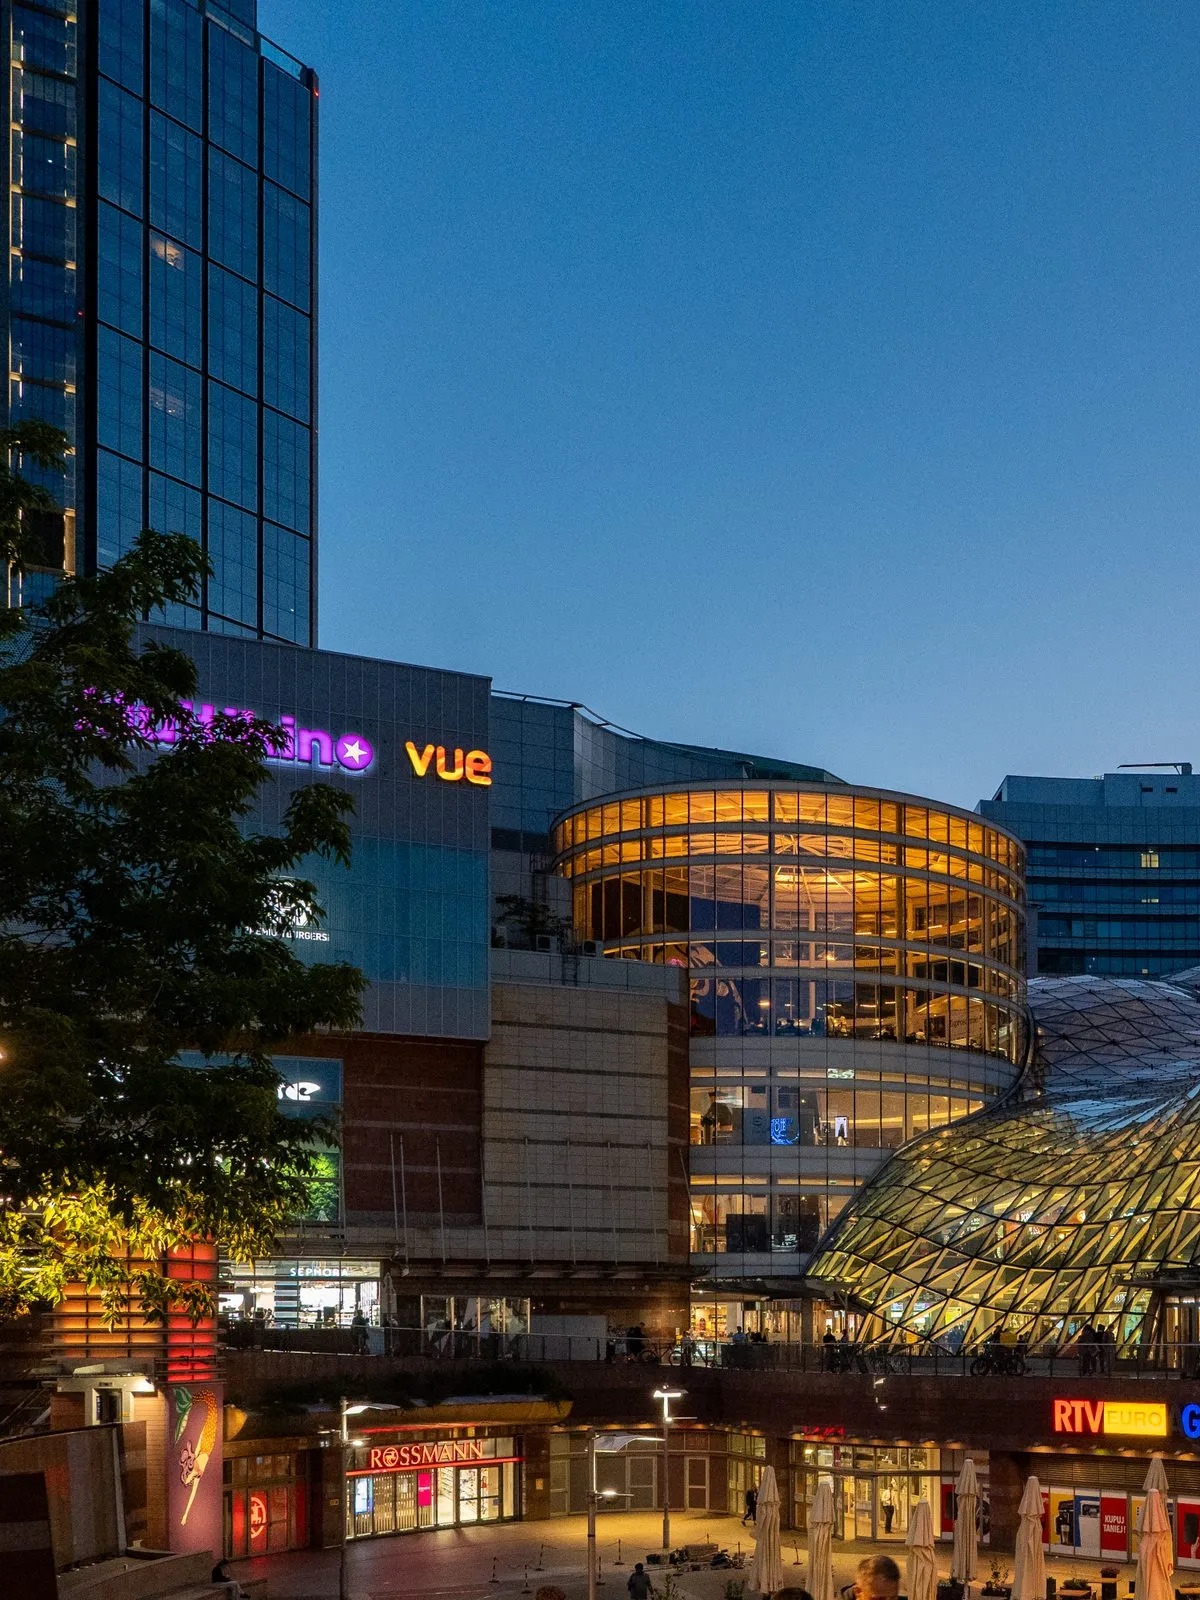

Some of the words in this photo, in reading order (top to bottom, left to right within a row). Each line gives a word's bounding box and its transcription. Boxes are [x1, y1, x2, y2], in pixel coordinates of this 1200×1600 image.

[405, 741, 493, 786] vue
[289, 1267, 348, 1277] SEPHORA
[1054, 1399, 1104, 1433] RTV
[1107, 1409, 1163, 1427] EURO
[370, 1441, 483, 1468] ROSSMANN
